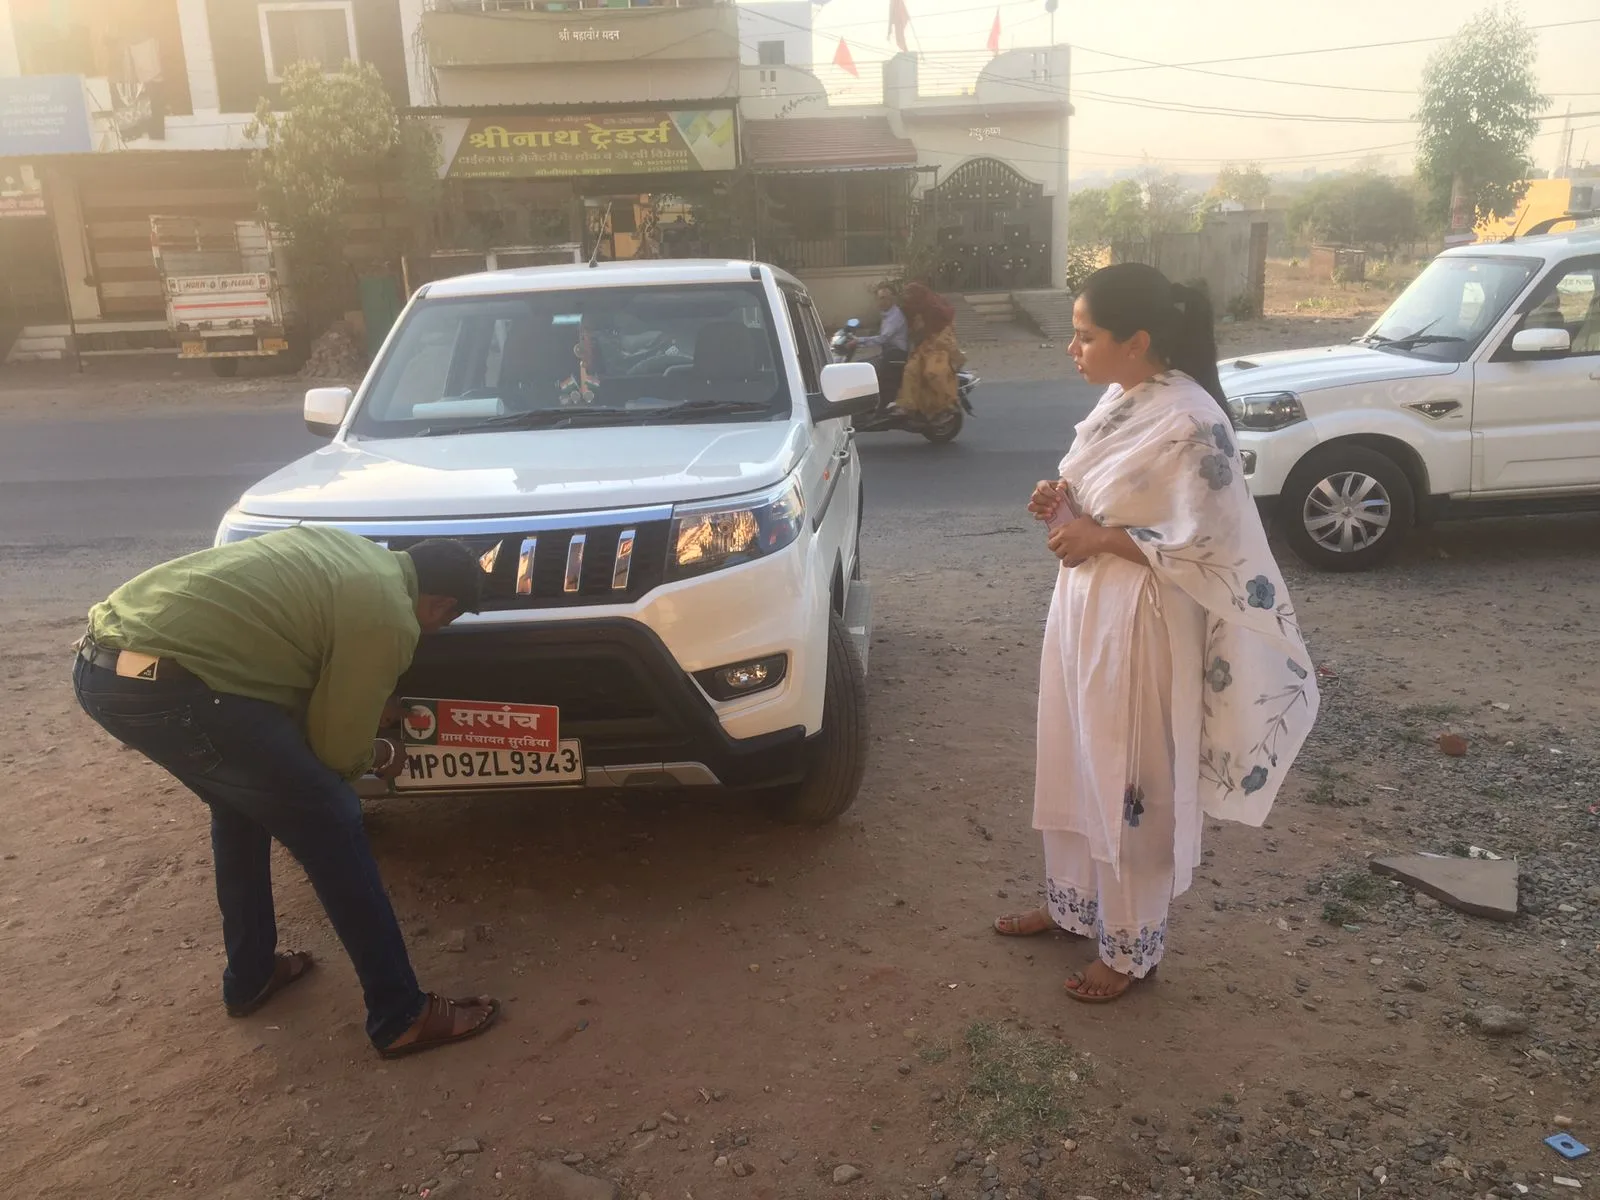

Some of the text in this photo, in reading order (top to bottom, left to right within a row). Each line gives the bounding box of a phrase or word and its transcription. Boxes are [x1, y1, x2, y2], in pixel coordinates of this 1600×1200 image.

[559, 27, 570, 41] श्री
[469, 120, 671, 151] श्रीनाथ ट्रेडर्स
[450, 705, 540, 731] सरपंच
[441, 731, 550, 749] ग्राम पंचायत सुरडिया
[407, 748, 577, 780] MP09ZL9343
